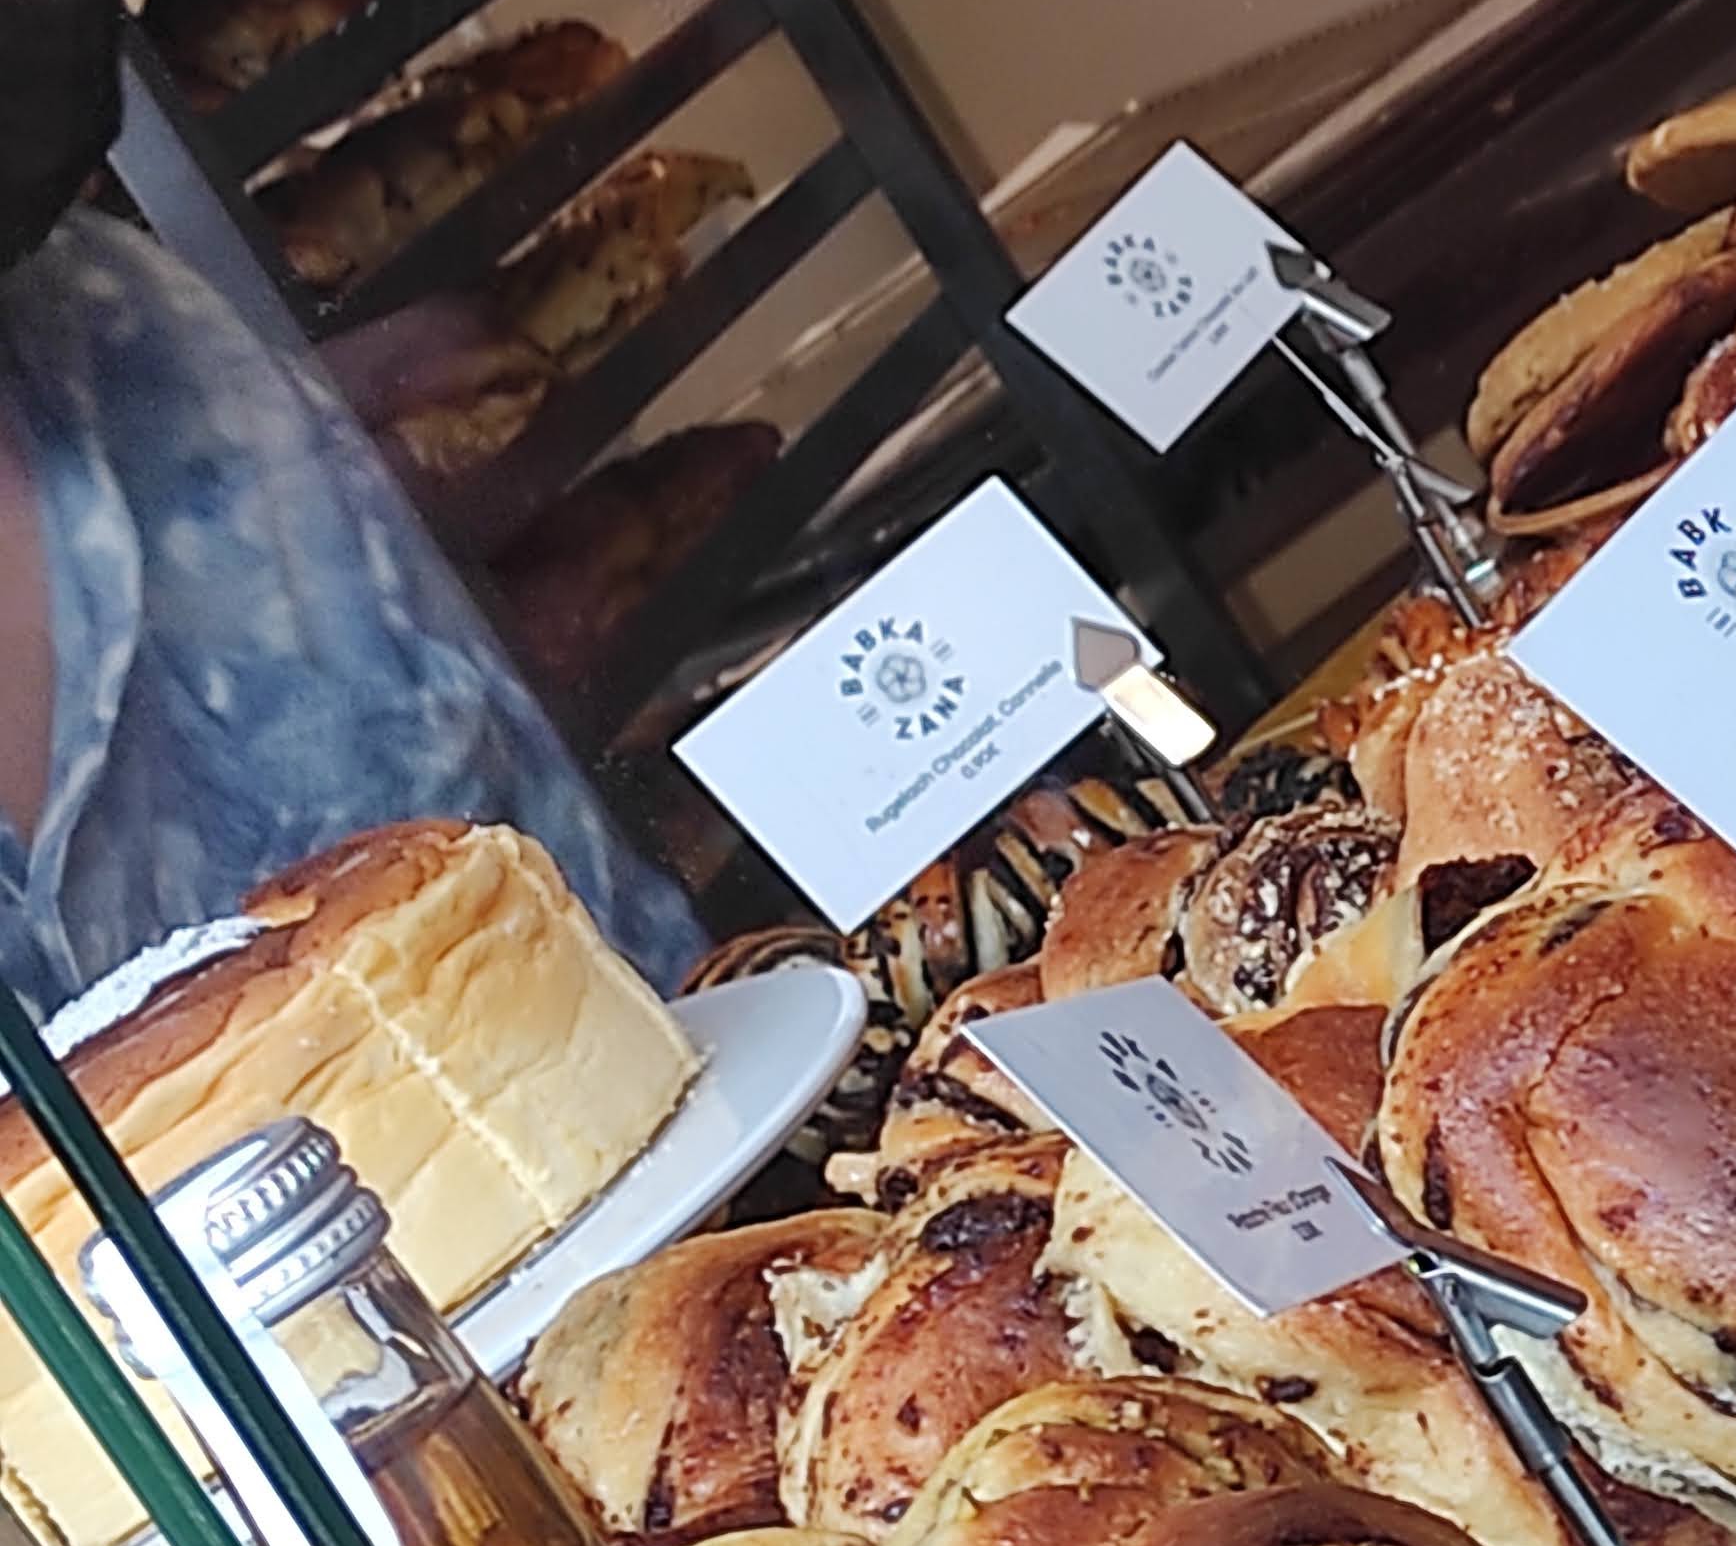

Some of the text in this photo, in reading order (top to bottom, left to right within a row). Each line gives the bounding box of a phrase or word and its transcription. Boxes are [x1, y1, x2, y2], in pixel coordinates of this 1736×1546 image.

[840, 617, 966, 740] BABKA ZANA
[865, 764, 936, 833] Rugelach
[997, 659, 1064, 716] Cannelle
